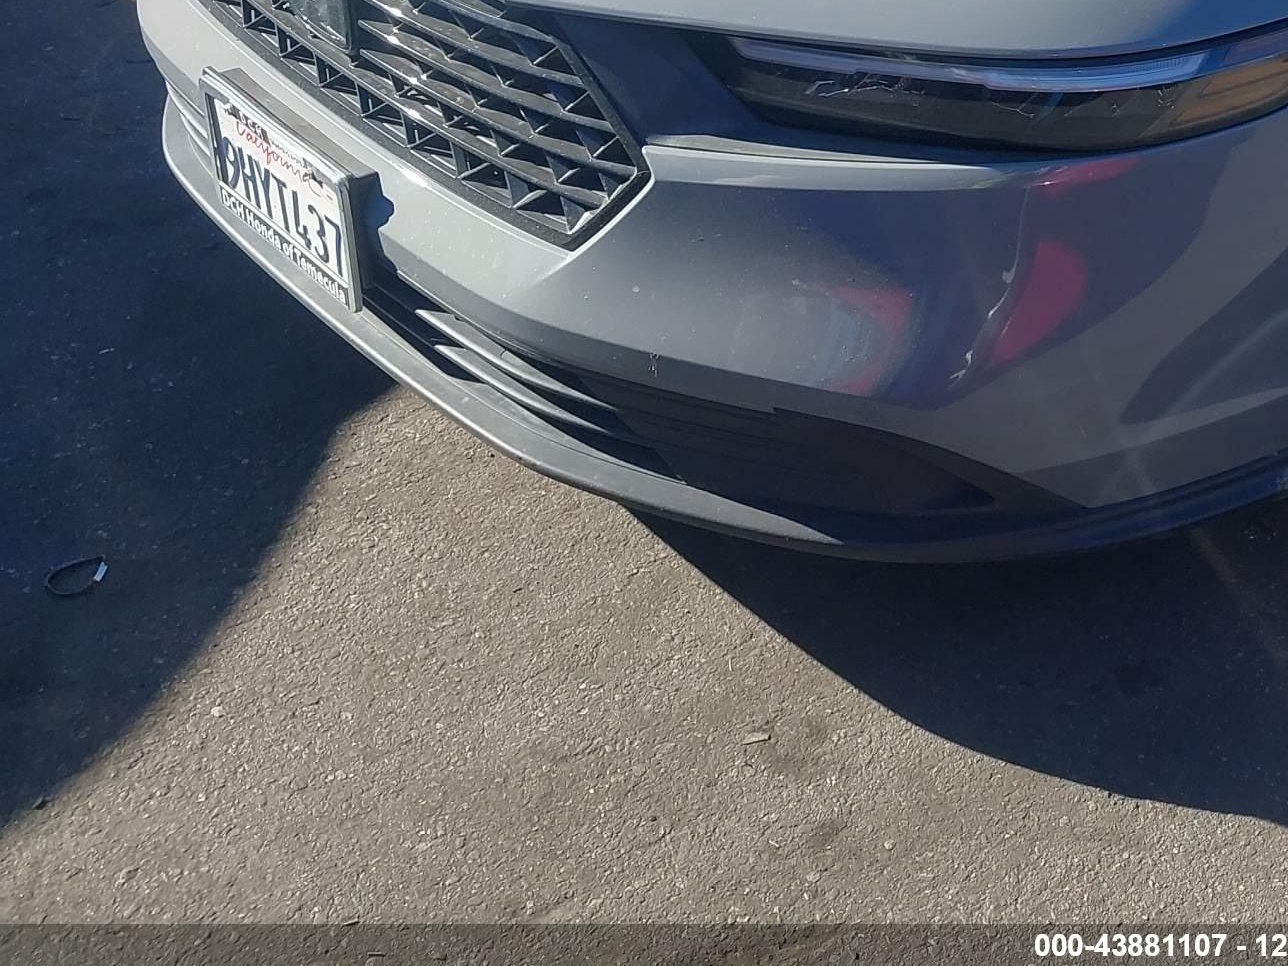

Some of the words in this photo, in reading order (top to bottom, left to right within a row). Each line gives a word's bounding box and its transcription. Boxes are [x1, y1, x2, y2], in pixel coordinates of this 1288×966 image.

[221, 136, 343, 277] 9HYT437
[221, 188, 245, 221] DCH
[246, 212, 282, 253] Honda
[281, 240, 297, 260] of
[293, 250, 347, 305] Temecula
